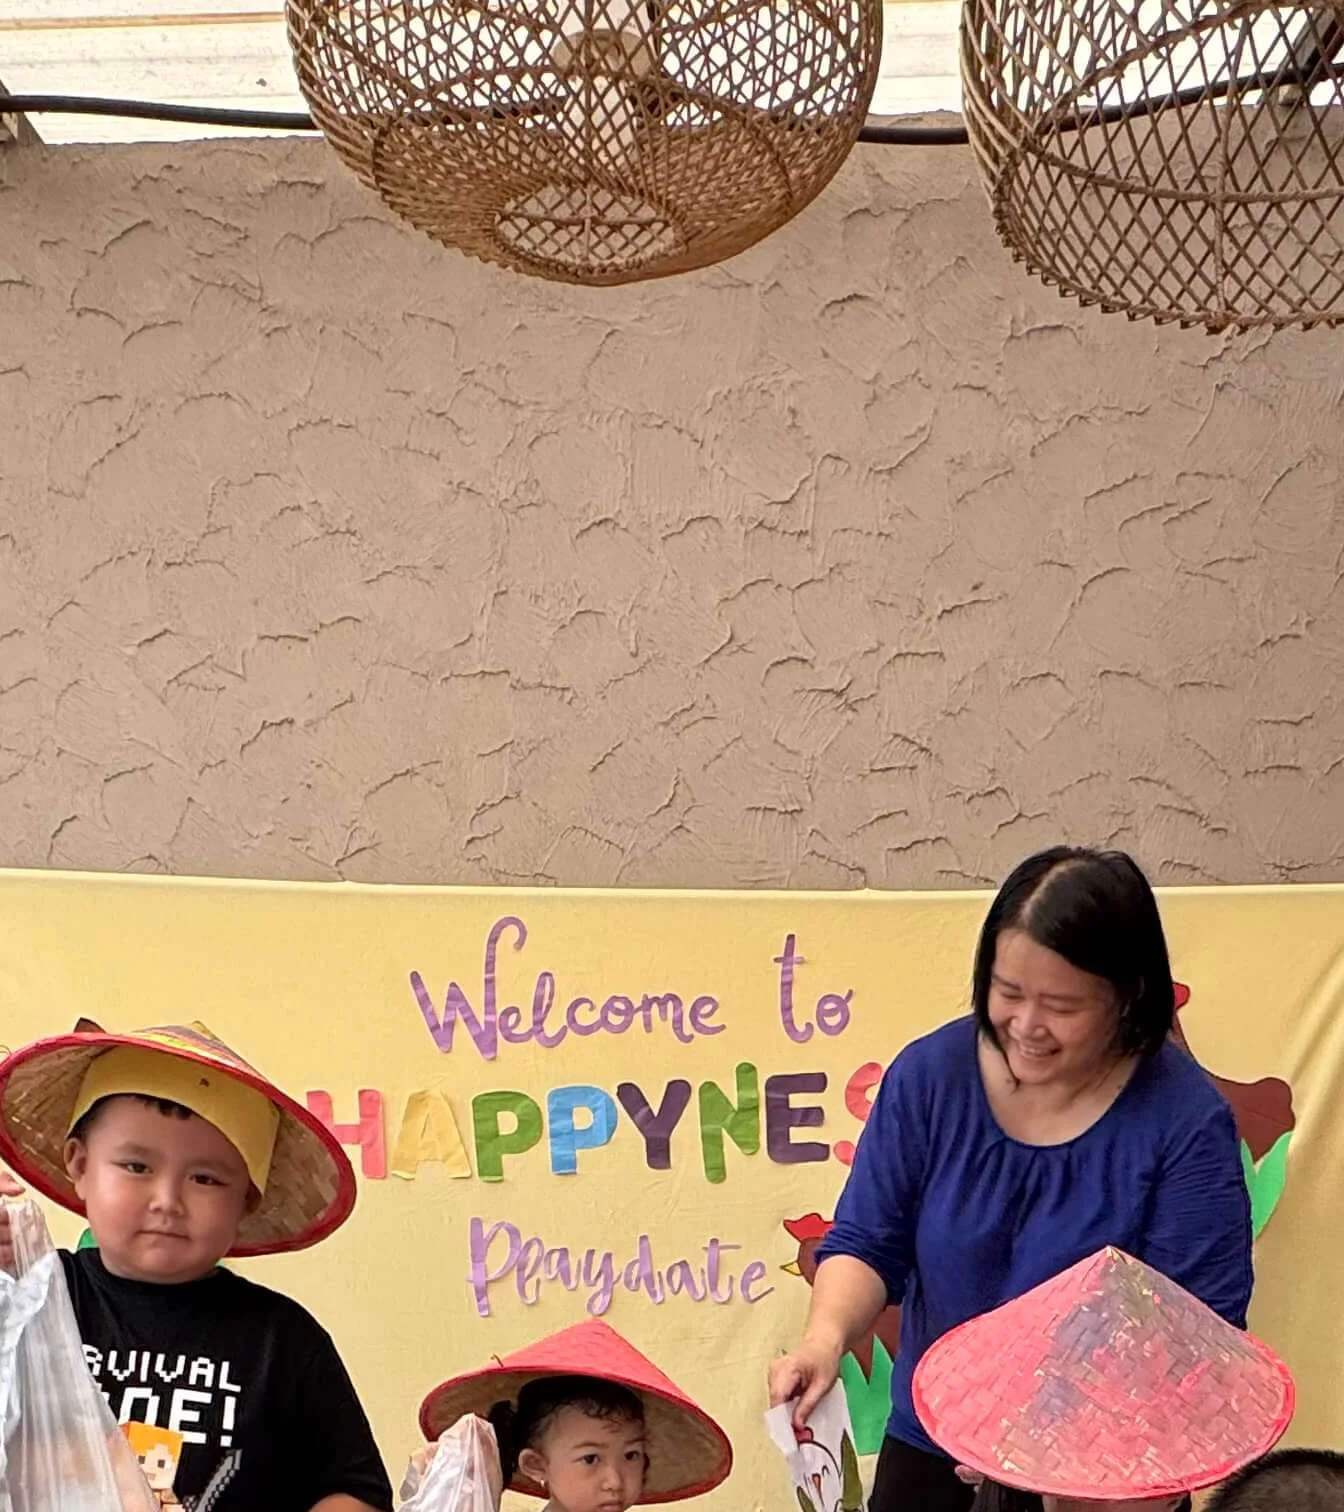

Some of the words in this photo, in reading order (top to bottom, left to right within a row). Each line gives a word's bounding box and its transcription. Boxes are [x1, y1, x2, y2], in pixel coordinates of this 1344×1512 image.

[410, 916, 726, 1062] Welcome
[772, 933, 855, 1045] to
[465, 1216, 775, 1318] Playdate
[81, 1343, 242, 1393] RVIVAL
